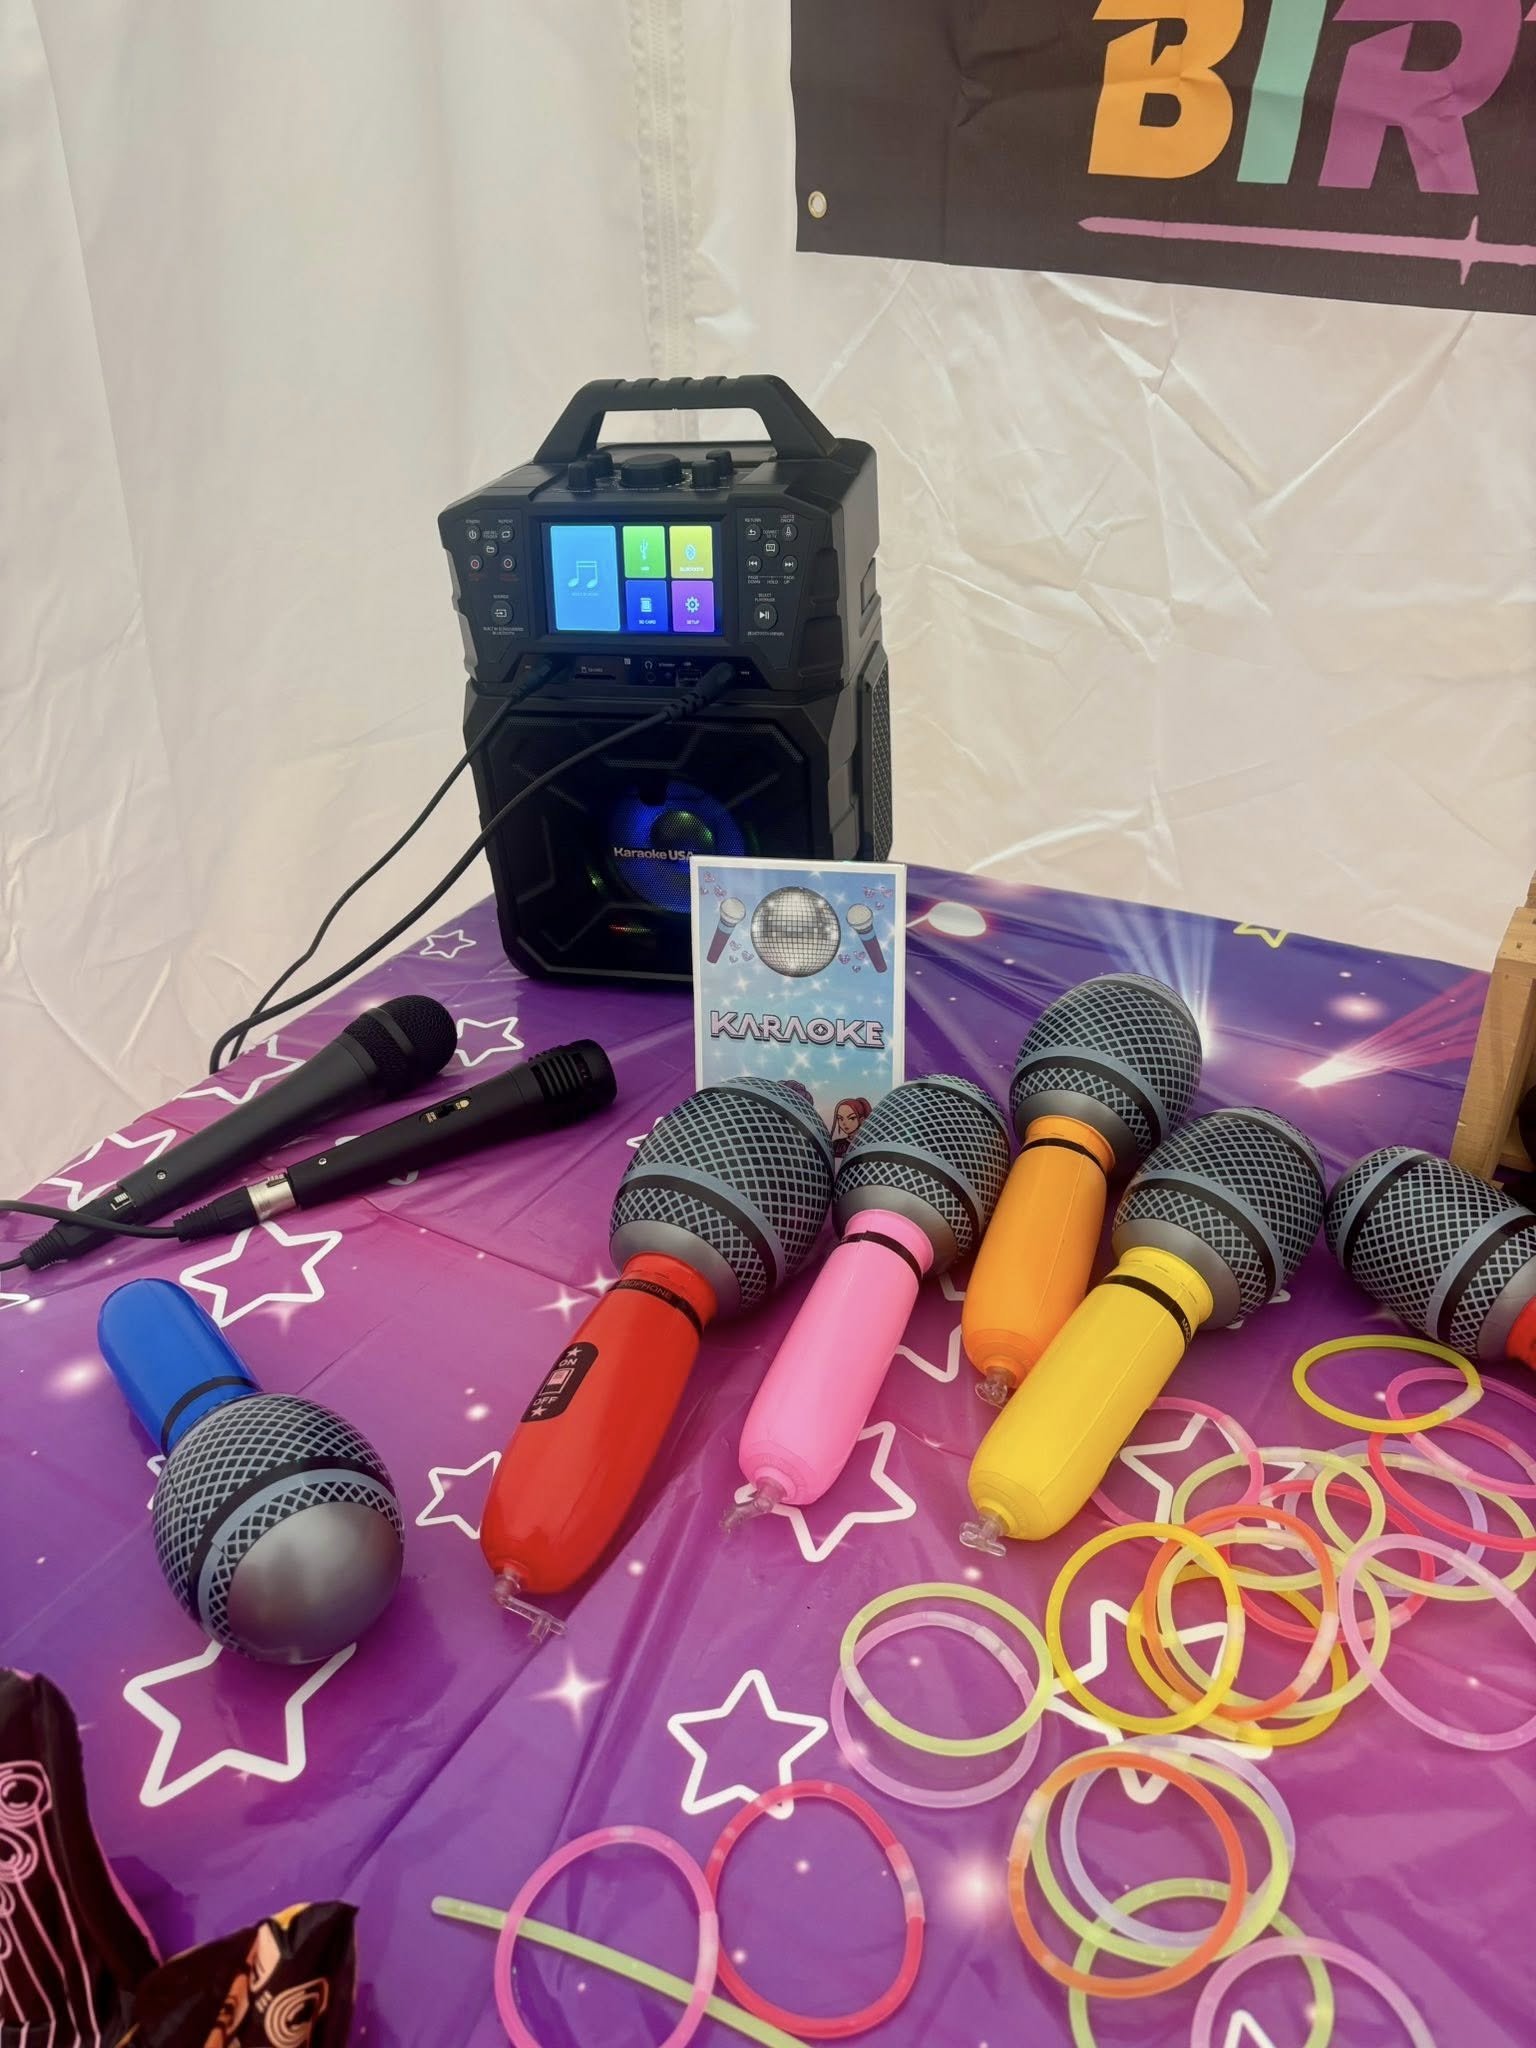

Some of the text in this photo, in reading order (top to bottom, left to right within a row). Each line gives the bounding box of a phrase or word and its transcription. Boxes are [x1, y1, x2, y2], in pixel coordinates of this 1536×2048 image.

[1088, 0, 1536, 195] BIR
[613, 847, 667, 860] Karaoke
[710, 1010, 886, 1050] KARAOKE
[559, 1358, 578, 1367] ON
[532, 1395, 558, 1407] OFF
